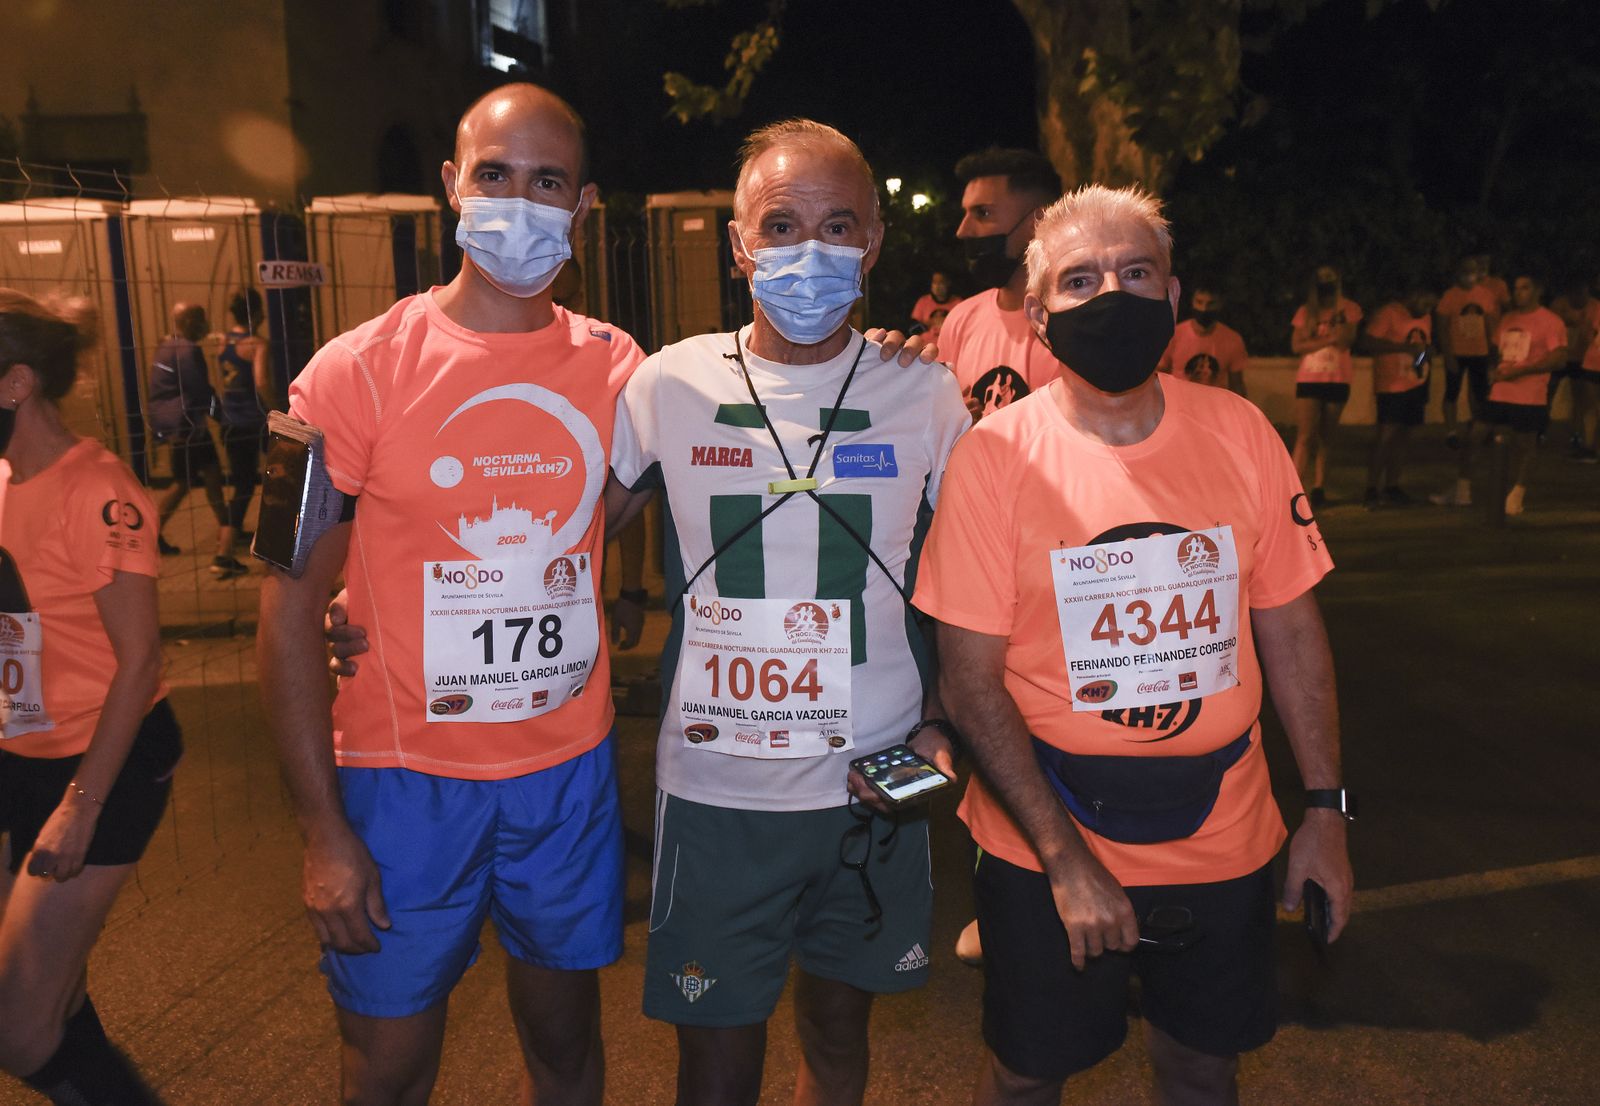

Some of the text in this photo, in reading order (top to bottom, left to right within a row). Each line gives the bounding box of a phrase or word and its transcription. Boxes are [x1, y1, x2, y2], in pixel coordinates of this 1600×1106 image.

[272, 264, 323, 282] REMSA
[473, 453, 541, 467] NOCTURNA
[691, 446, 753, 468] MARCA
[836, 453, 876, 464] Sanitas
[483, 465, 534, 477] SEVILLA
[497, 534, 527, 546] 2020
[1084, 592, 1116, 602] CARRERA
[1116, 586, 1153, 598] NOCTURNA
[1154, 585, 1167, 593] DEL
[1167, 577, 1213, 591] GUADALQUIVIR
[450, 608, 481, 616] CARRERA
[482, 605, 519, 615] NOCTURNA
[519, 605, 531, 613] DEL
[532, 600, 570, 612] GUADALQUIVIR
[1090, 588, 1221, 649] 4344
[472, 614, 564, 665] 178
[702, 641, 723, 650] CARRERA
[723, 645, 756, 653] NOCTURNA
[1070, 636, 1238, 672] FERNANDO FERNANDEZ CORDERO
[435, 658, 589, 687] JUAN MANUEL GARCIA LIMON
[705, 654, 824, 703] 1064
[681, 702, 706, 715] JUAN
[708, 704, 751, 720] MANUEL
[751, 710, 794, 722] GARCIA
[796, 709, 848, 721] VAZQUEZ
[894, 956, 929, 972] adidas
